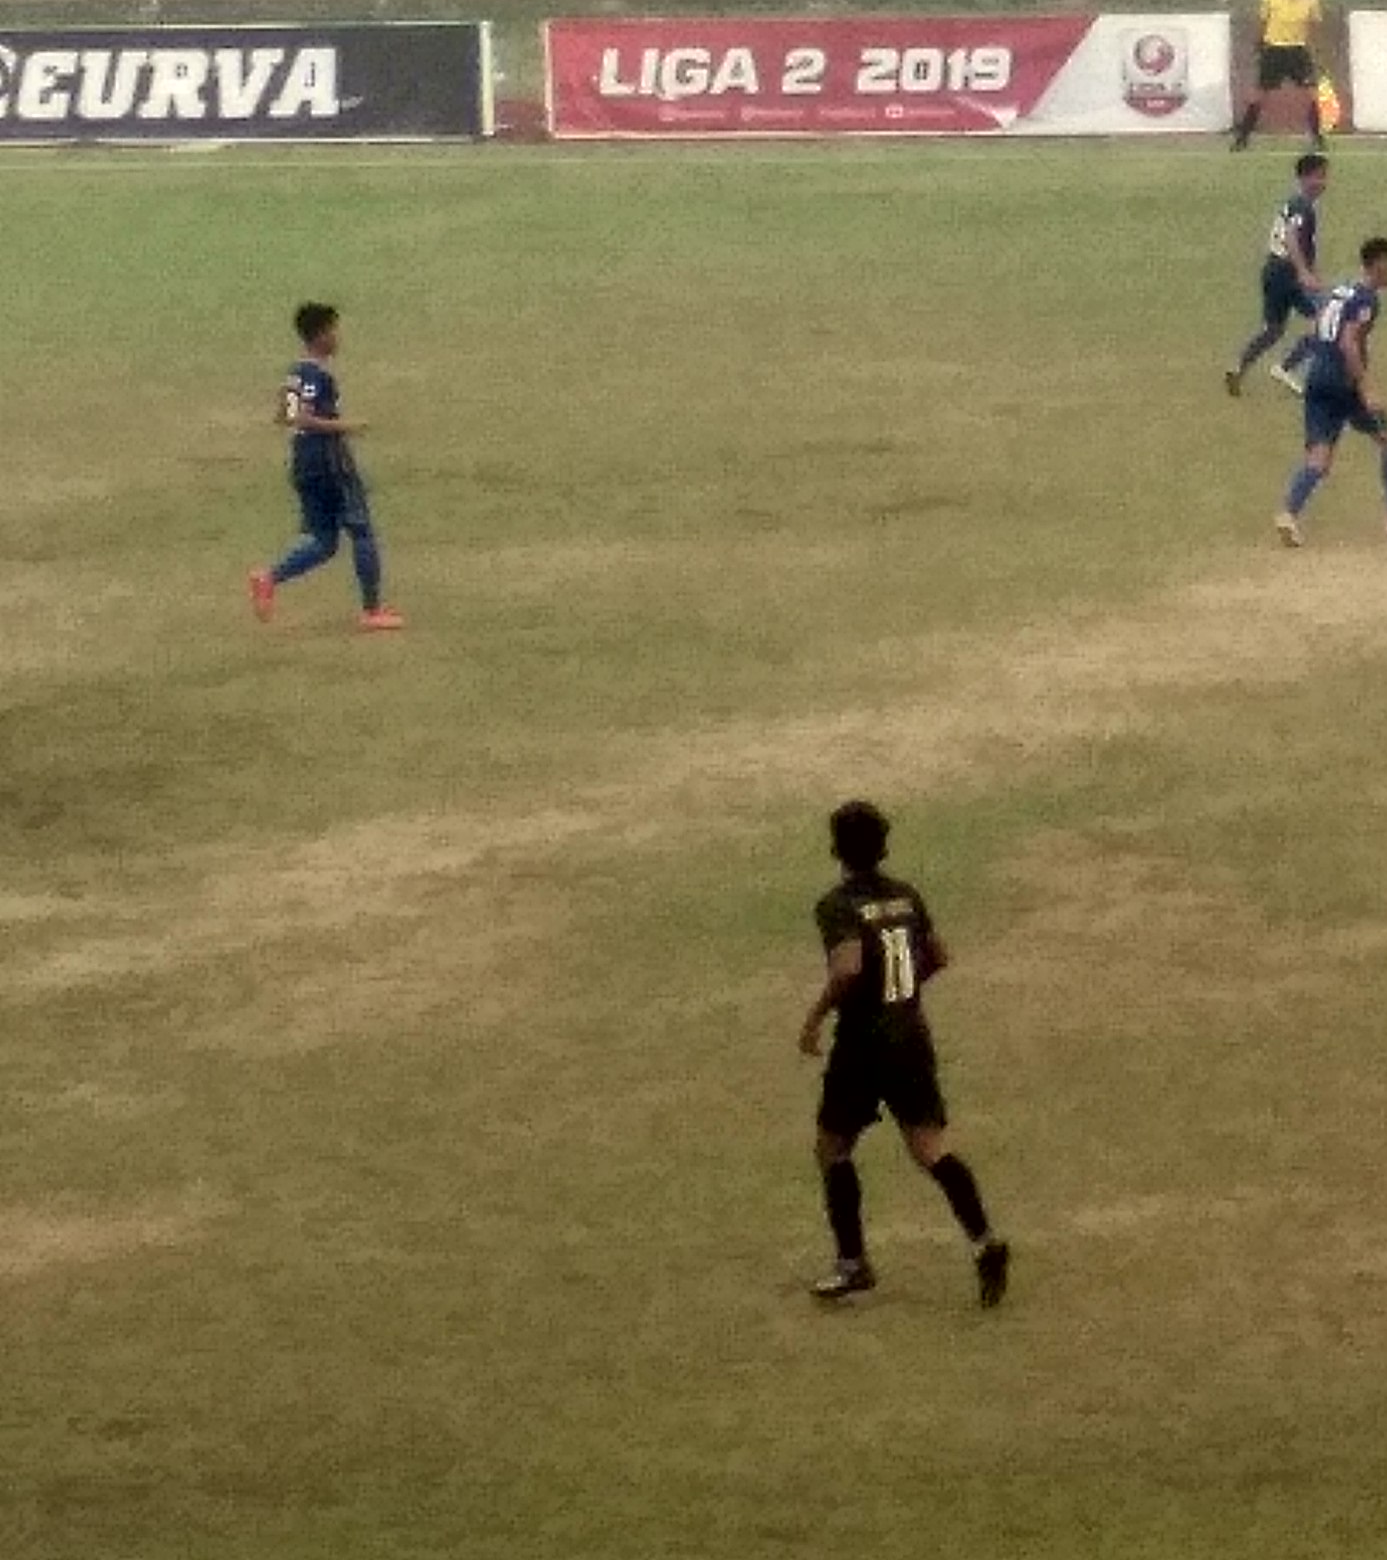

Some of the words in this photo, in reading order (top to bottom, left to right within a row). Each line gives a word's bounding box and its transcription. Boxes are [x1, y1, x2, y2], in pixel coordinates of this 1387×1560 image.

[17, 47, 344, 119] CURVA
[599, 47, 761, 95] LIGA
[780, 47, 826, 94] 2
[857, 46, 1013, 93] 2019
